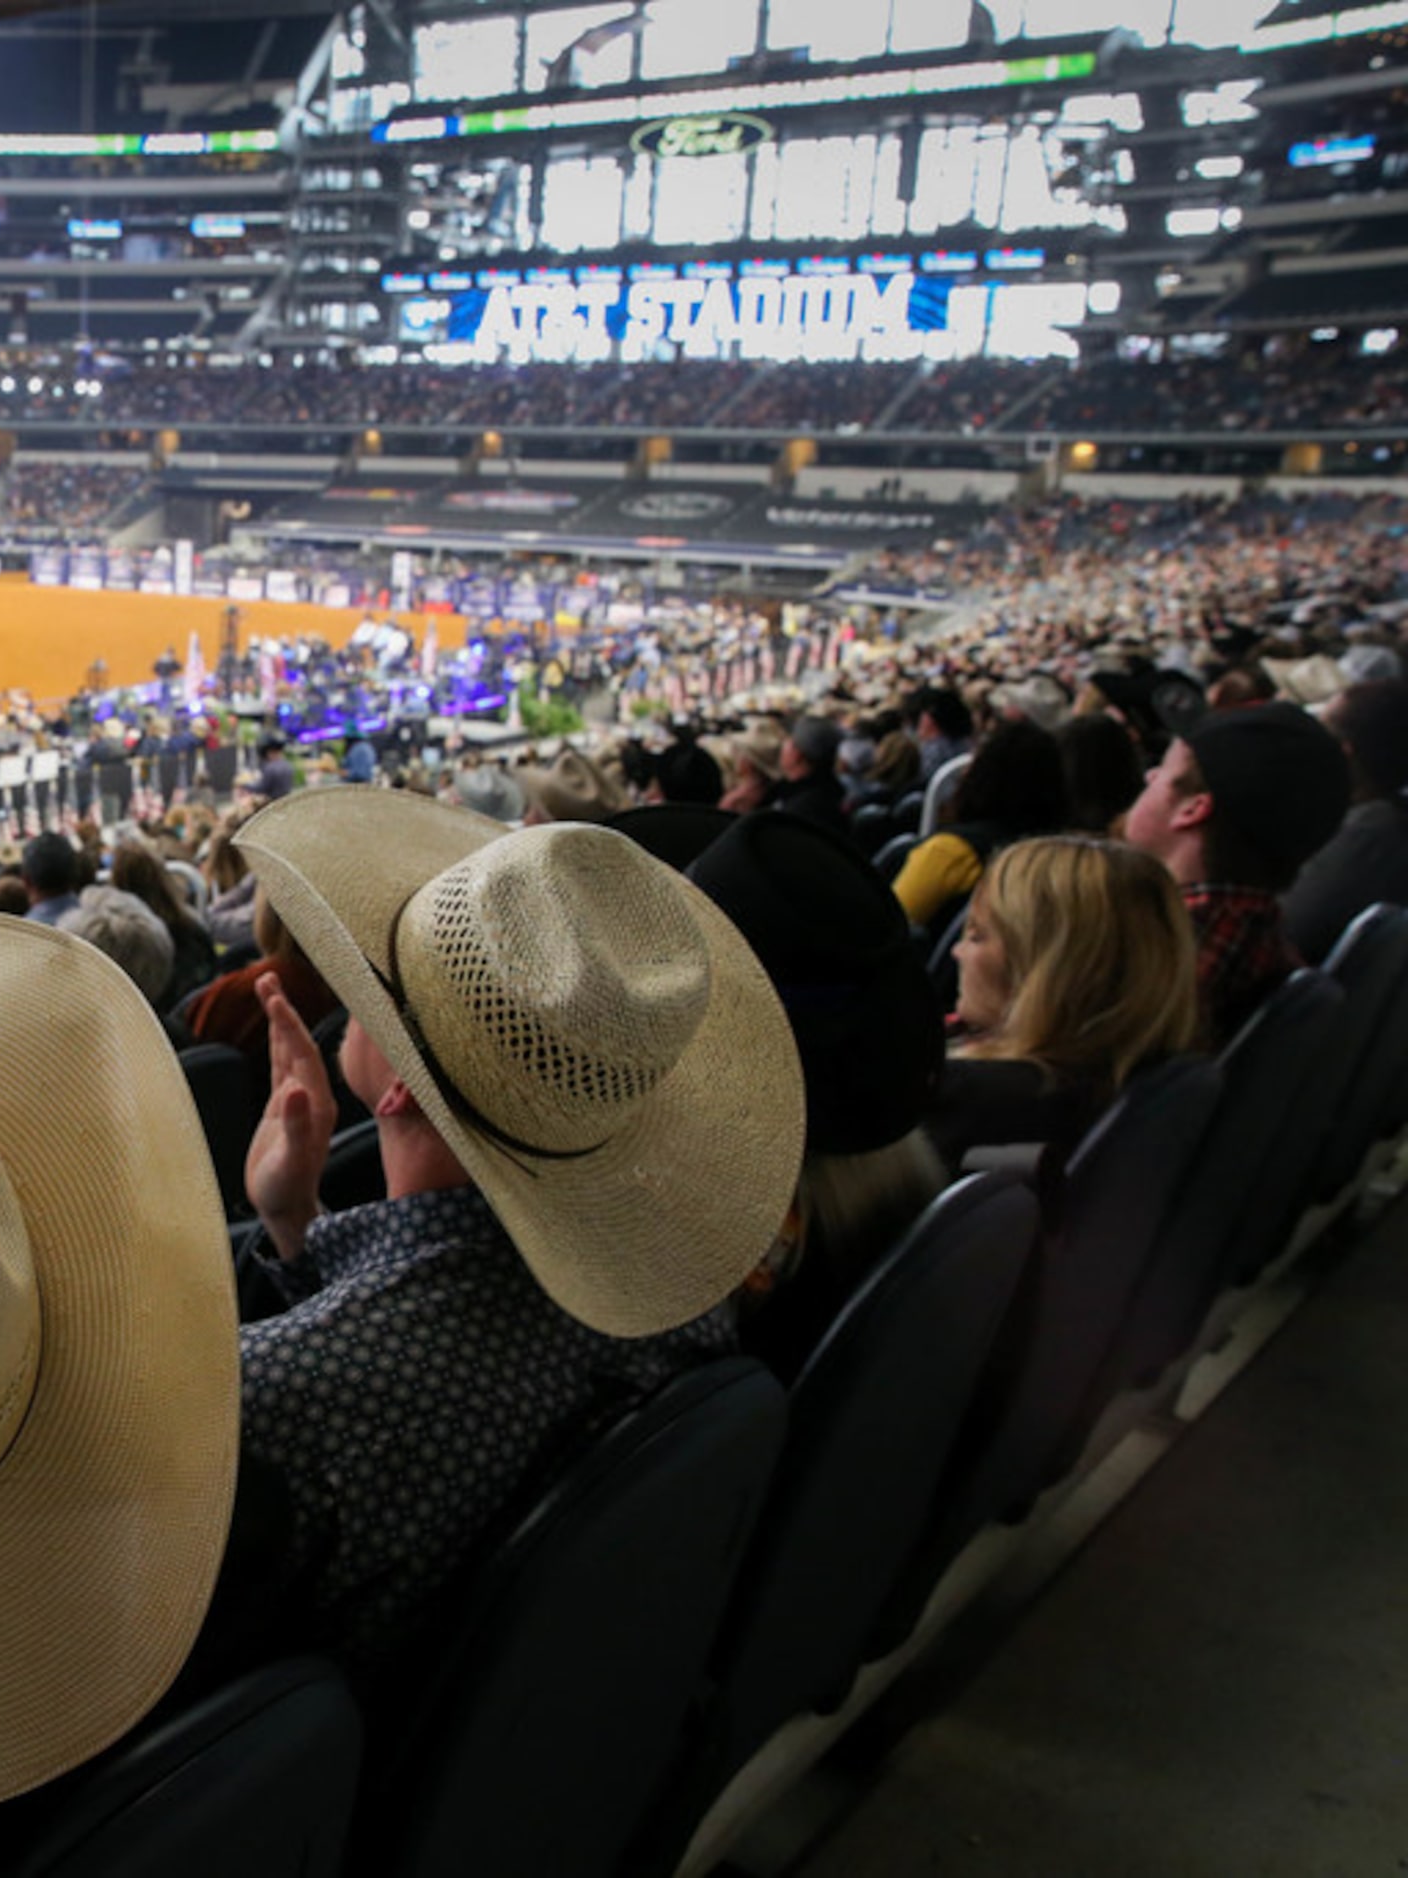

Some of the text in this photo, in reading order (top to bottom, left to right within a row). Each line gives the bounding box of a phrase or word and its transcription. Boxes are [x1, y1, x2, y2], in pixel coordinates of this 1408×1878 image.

[657, 118, 743, 156] Ford
[476, 274, 915, 350] AT&T STADIUM
